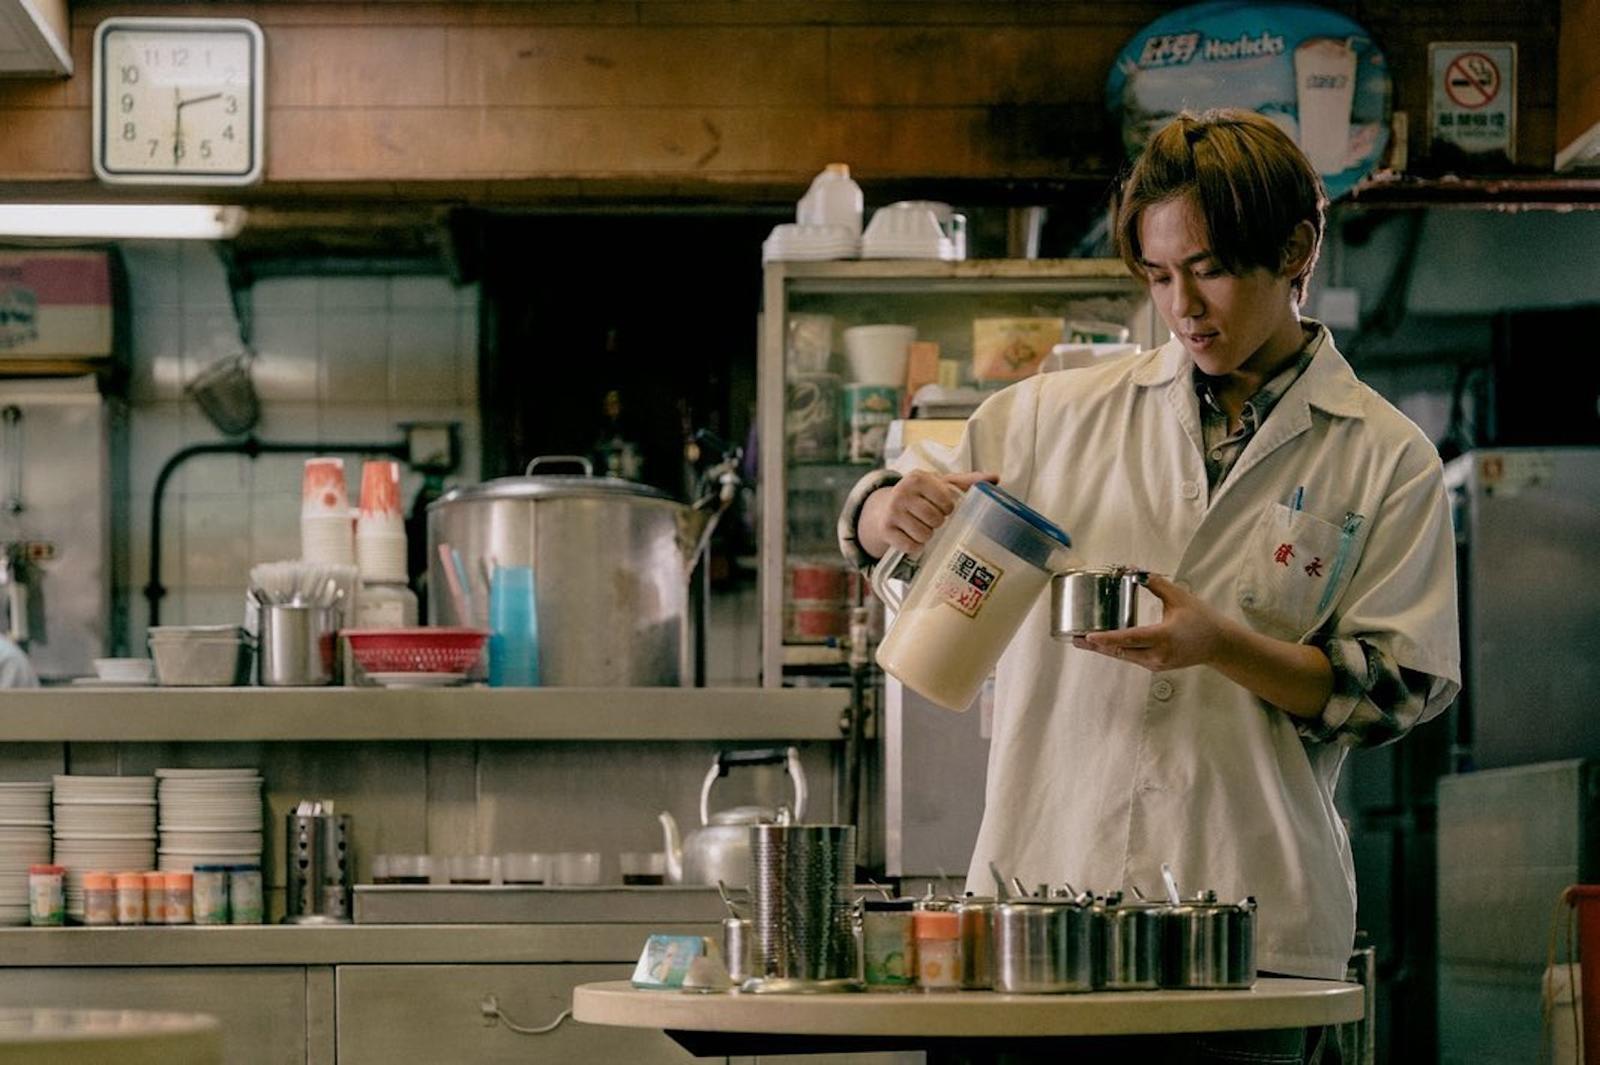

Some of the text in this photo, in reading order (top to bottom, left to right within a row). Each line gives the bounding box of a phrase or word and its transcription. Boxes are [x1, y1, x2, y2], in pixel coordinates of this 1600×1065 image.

[1205, 32, 1285, 61] Horlicks
[145, 49, 159, 65] 11
[172, 48, 189, 66] 12
[121, 65, 140, 84] 10
[121, 94, 134, 113] 9
[225, 95, 237, 114] 3
[122, 122, 136, 141] 8
[222, 125, 234, 140] 4
[148, 139, 159, 158] 7
[200, 140, 212, 158] 5
